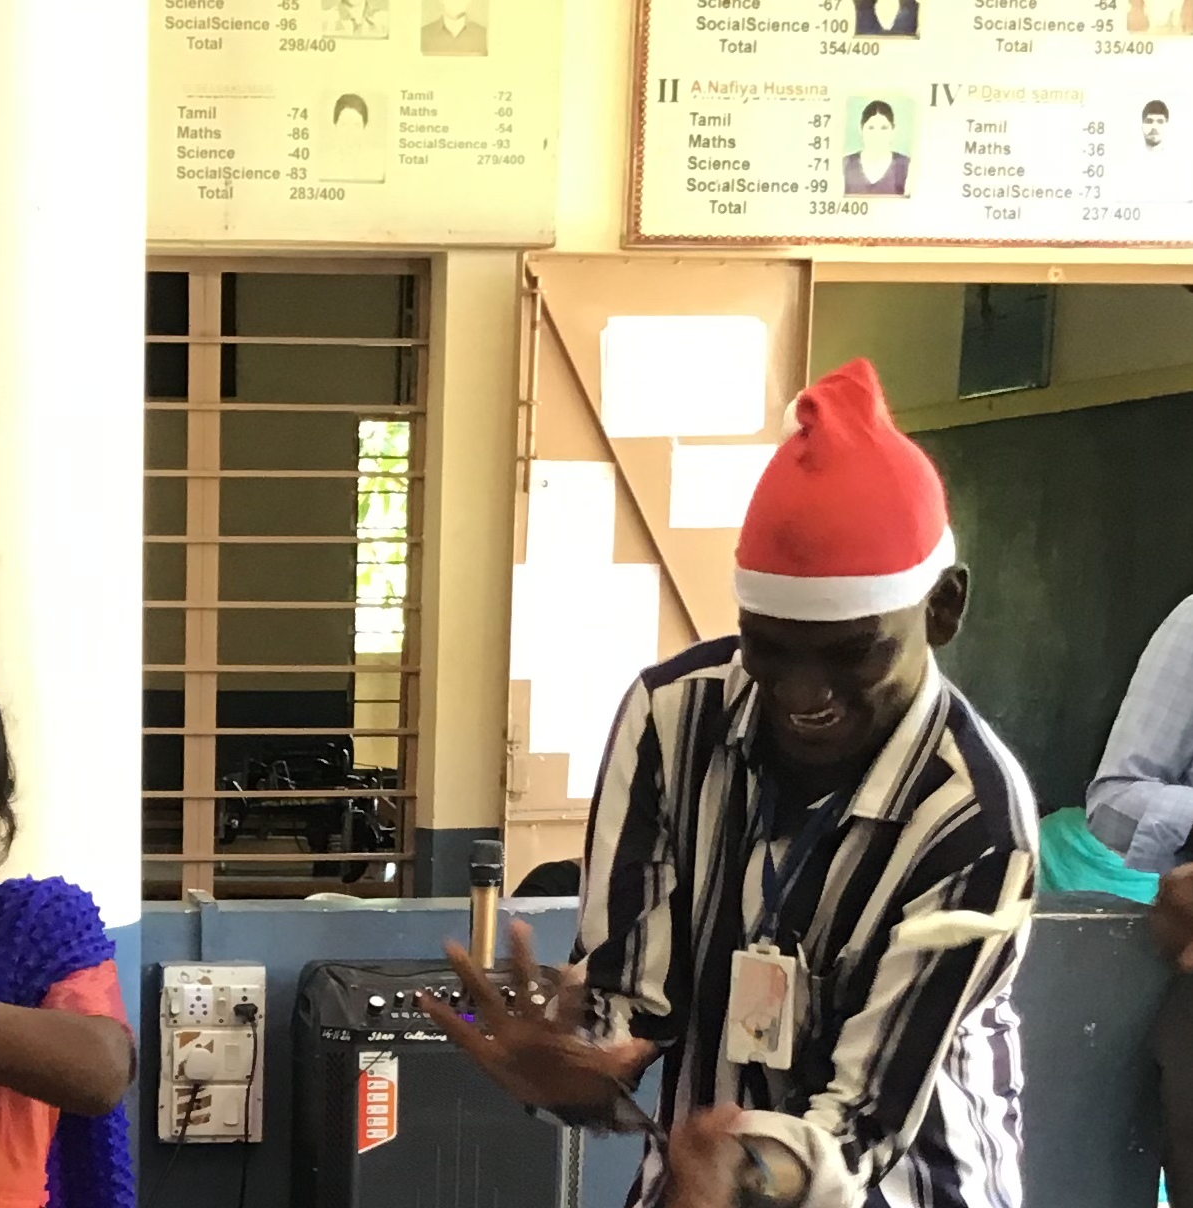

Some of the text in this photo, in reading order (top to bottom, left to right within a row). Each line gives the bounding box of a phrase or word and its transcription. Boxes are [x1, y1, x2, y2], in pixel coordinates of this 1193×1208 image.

[165, 0, 224, 9] Science
[697, 0, 760, 9] Science
[974, 0, 1037, 9] Science
[165, 16, 297, 31] SocialScience -96
[696, 16, 849, 33] SocialScience -100
[973, 16, 1114, 32] SocialScience -95
[186, 36, 336, 52] Total 298/400
[719, 39, 880, 56] Total 354/400
[995, 38, 1154, 55] Total 335/400
[400, 90, 512, 102] Tamil -72
[658, 79, 680, 102] II
[764, 82, 828, 96] Hussina
[930, 83, 962, 107] IV
[177, 106, 308, 121] Tamil -74
[400, 106, 513, 118] Maths -60
[399, 122, 449, 133] Science
[689, 112, 831, 128] Tamil -87
[966, 119, 1105, 135] Tamil -68
[177, 126, 310, 140] Maths -86
[399, 138, 488, 149] SocialScience
[688, 134, 830, 150] Maths -81
[964, 141, 1105, 157] Maths -36
[177, 146, 310, 161] Science -40
[398, 154, 429, 165] Total
[687, 156, 830, 171] Science -71
[963, 162, 1104, 178] Science -60
[176, 166, 307, 181] SocialScience -83
[686, 178, 828, 193] SocialScience -99
[961, 184, 1101, 200] SocialScience -73
[198, 186, 345, 201] Total 283/400
[709, 200, 869, 216] Total 338/400
[985, 206, 1021, 220] Total
